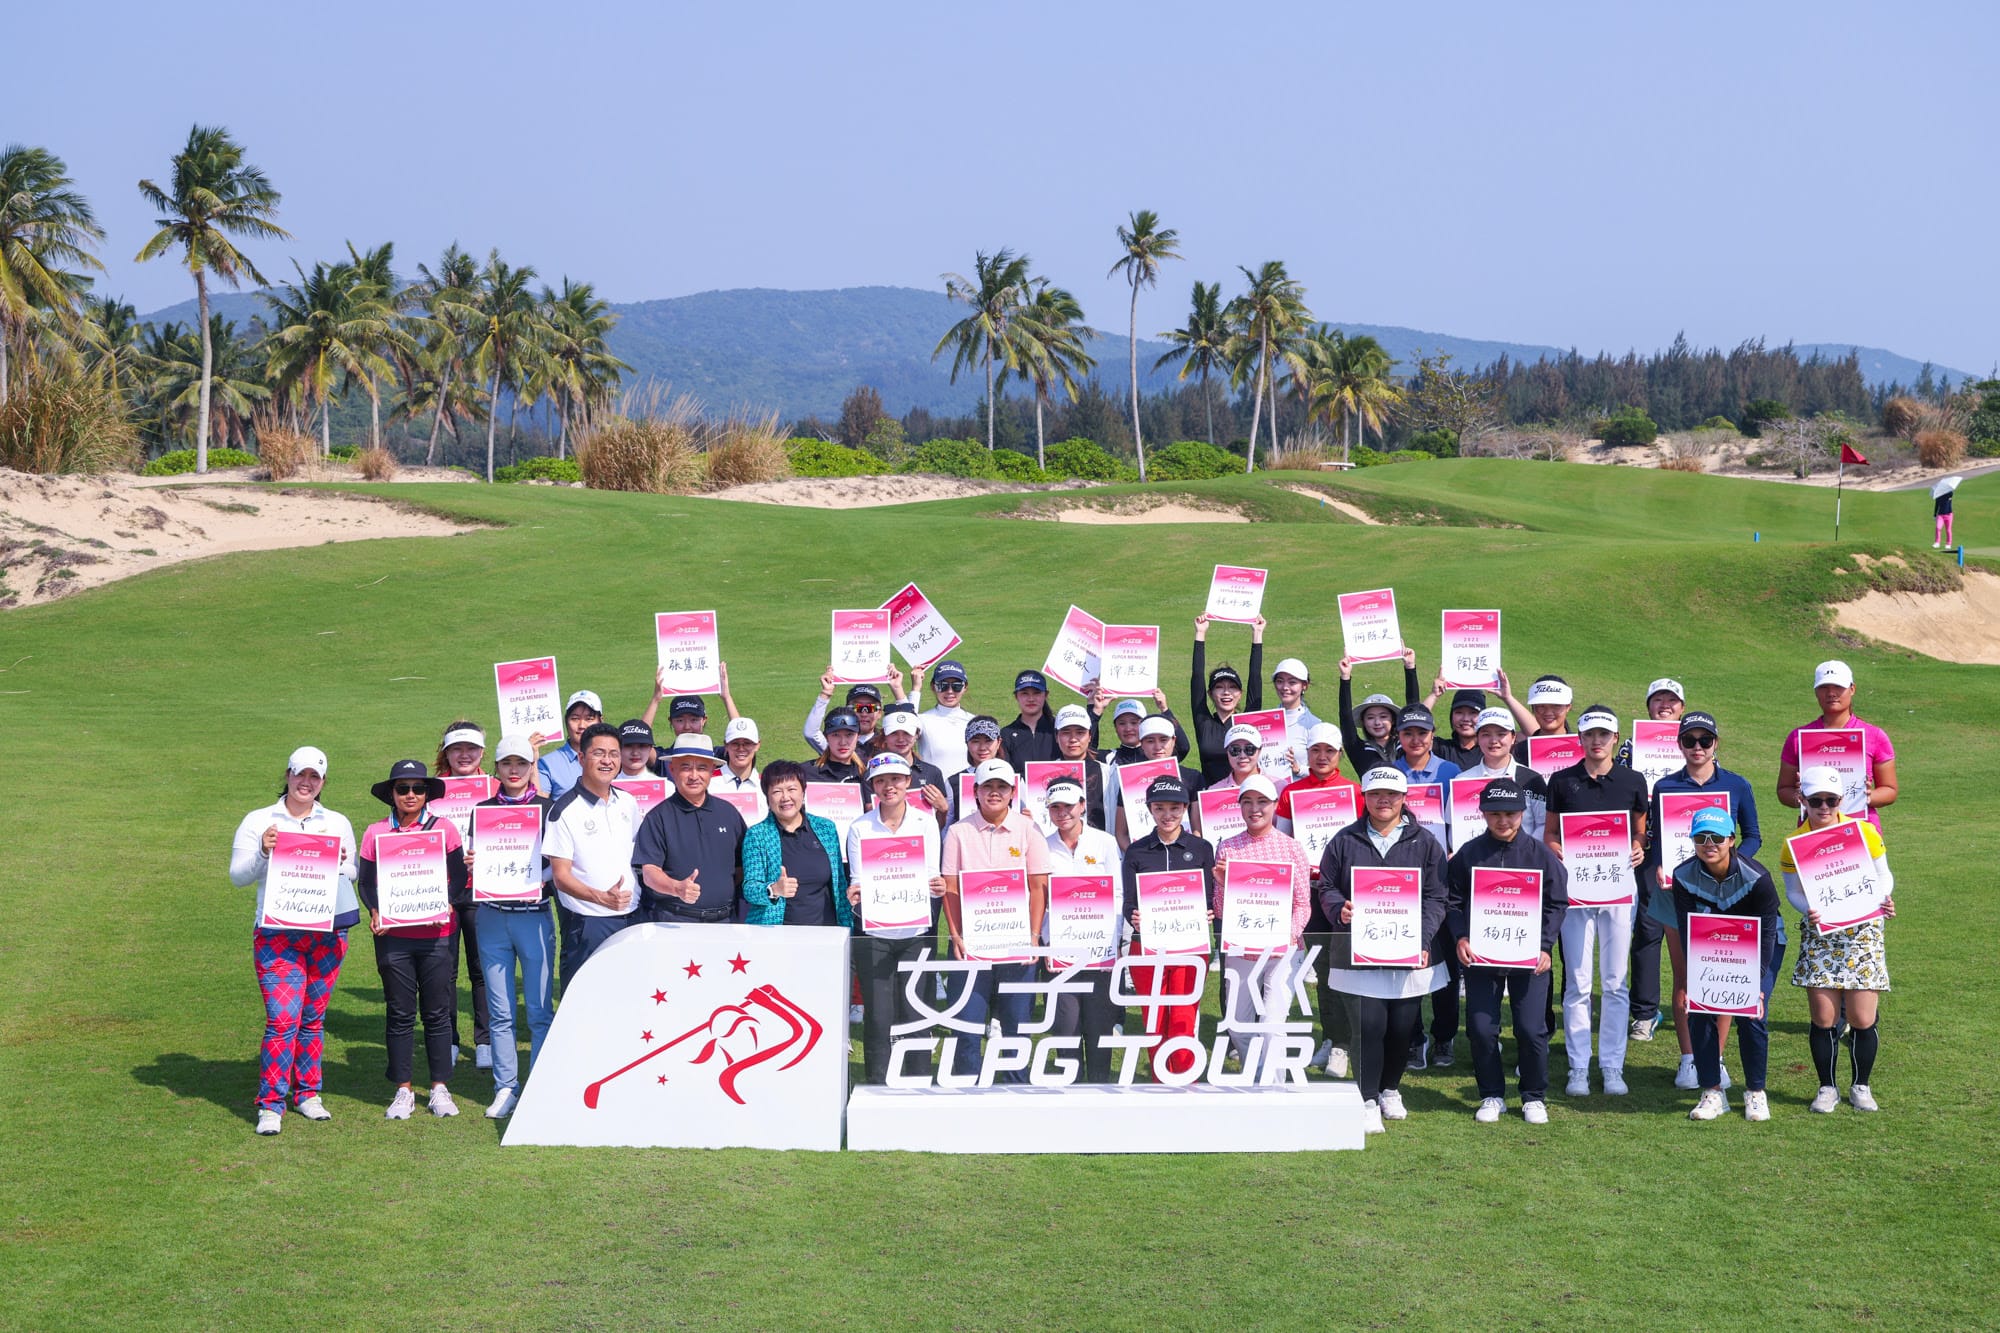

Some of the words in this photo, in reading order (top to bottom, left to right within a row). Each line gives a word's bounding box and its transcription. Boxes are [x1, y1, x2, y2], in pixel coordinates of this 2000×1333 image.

[1535, 684, 1562, 694] Titleist
[676, 701, 699, 710] Titleist
[1061, 712, 1086, 721] Titleist
[1402, 713, 1427, 722] Titleist
[1683, 715, 1714, 726] Titleist
[622, 725, 649, 736] Titleist
[1230, 728, 1255, 736] Titleist
[1369, 771, 1399, 781] Titleist
[1153, 782, 1183, 793] Titleist
[1488, 788, 1518, 798] Titleist
[1305, 822, 1323, 830] CLPGA
[1323, 820, 1346, 828] MEMBER
[1594, 851, 1619, 859] MEMBER
[300, 872, 326, 880] MEMBER
[409, 869, 434, 877] MEMBER
[1814, 871, 1834, 881] CLPGA
[1834, 863, 1860, 875] MEMBER
[279, 882, 327, 898] Supamas
[273, 899, 334, 915] SANGCHAN
[1255, 899, 1280, 907] MEMBER
[1237, 910, 1279, 931] 唐元平
[1483, 925, 1528, 947] 杨月华
[1701, 955, 1719, 963] CLPGA
[1720, 957, 1747, 965] MEMBER
[1700, 966, 1752, 984] Panitta
[890, 945, 1322, 1034] 女子中巡
[1701, 987, 1750, 1006] YUSABI
[884, 1036, 1081, 1088] CLPG
[1097, 1036, 1316, 1088] TOUR
